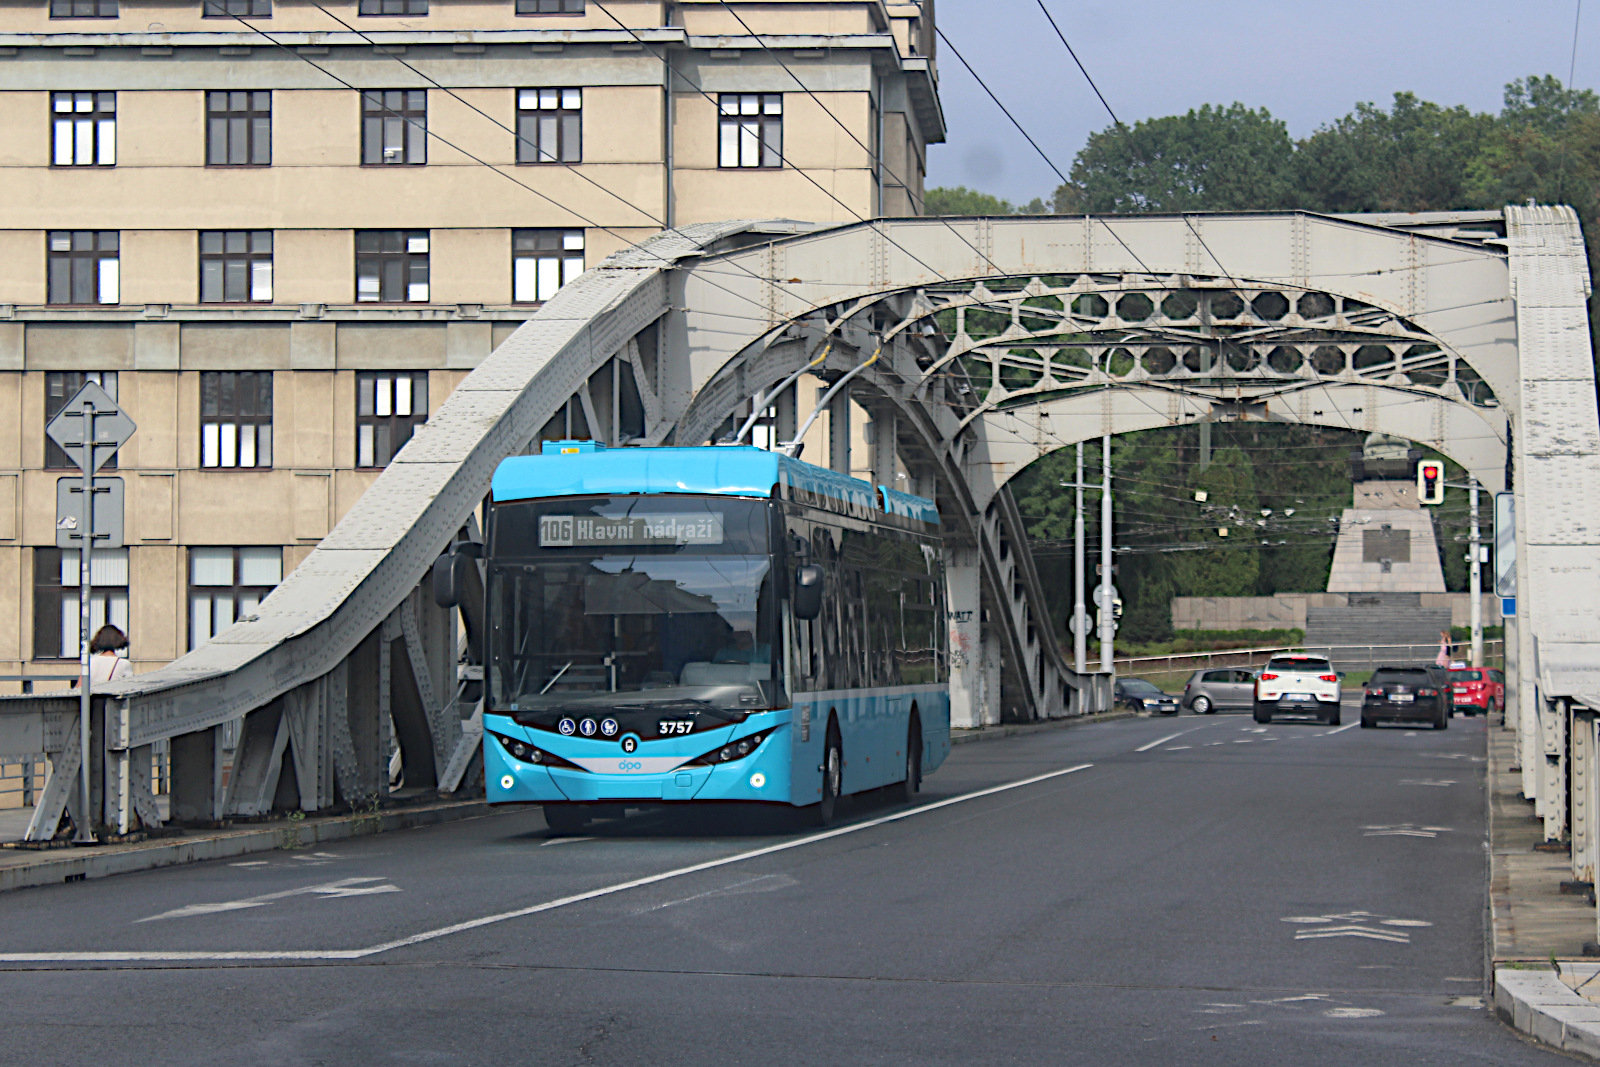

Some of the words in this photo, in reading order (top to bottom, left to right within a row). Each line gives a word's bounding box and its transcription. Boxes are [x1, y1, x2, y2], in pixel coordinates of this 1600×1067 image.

[541, 520, 572, 541] 106
[577, 520, 634, 540] Hlavní
[643, 519, 713, 539] nádraží
[660, 722, 693, 733] 3757
[619, 760, 641, 772] dpo
